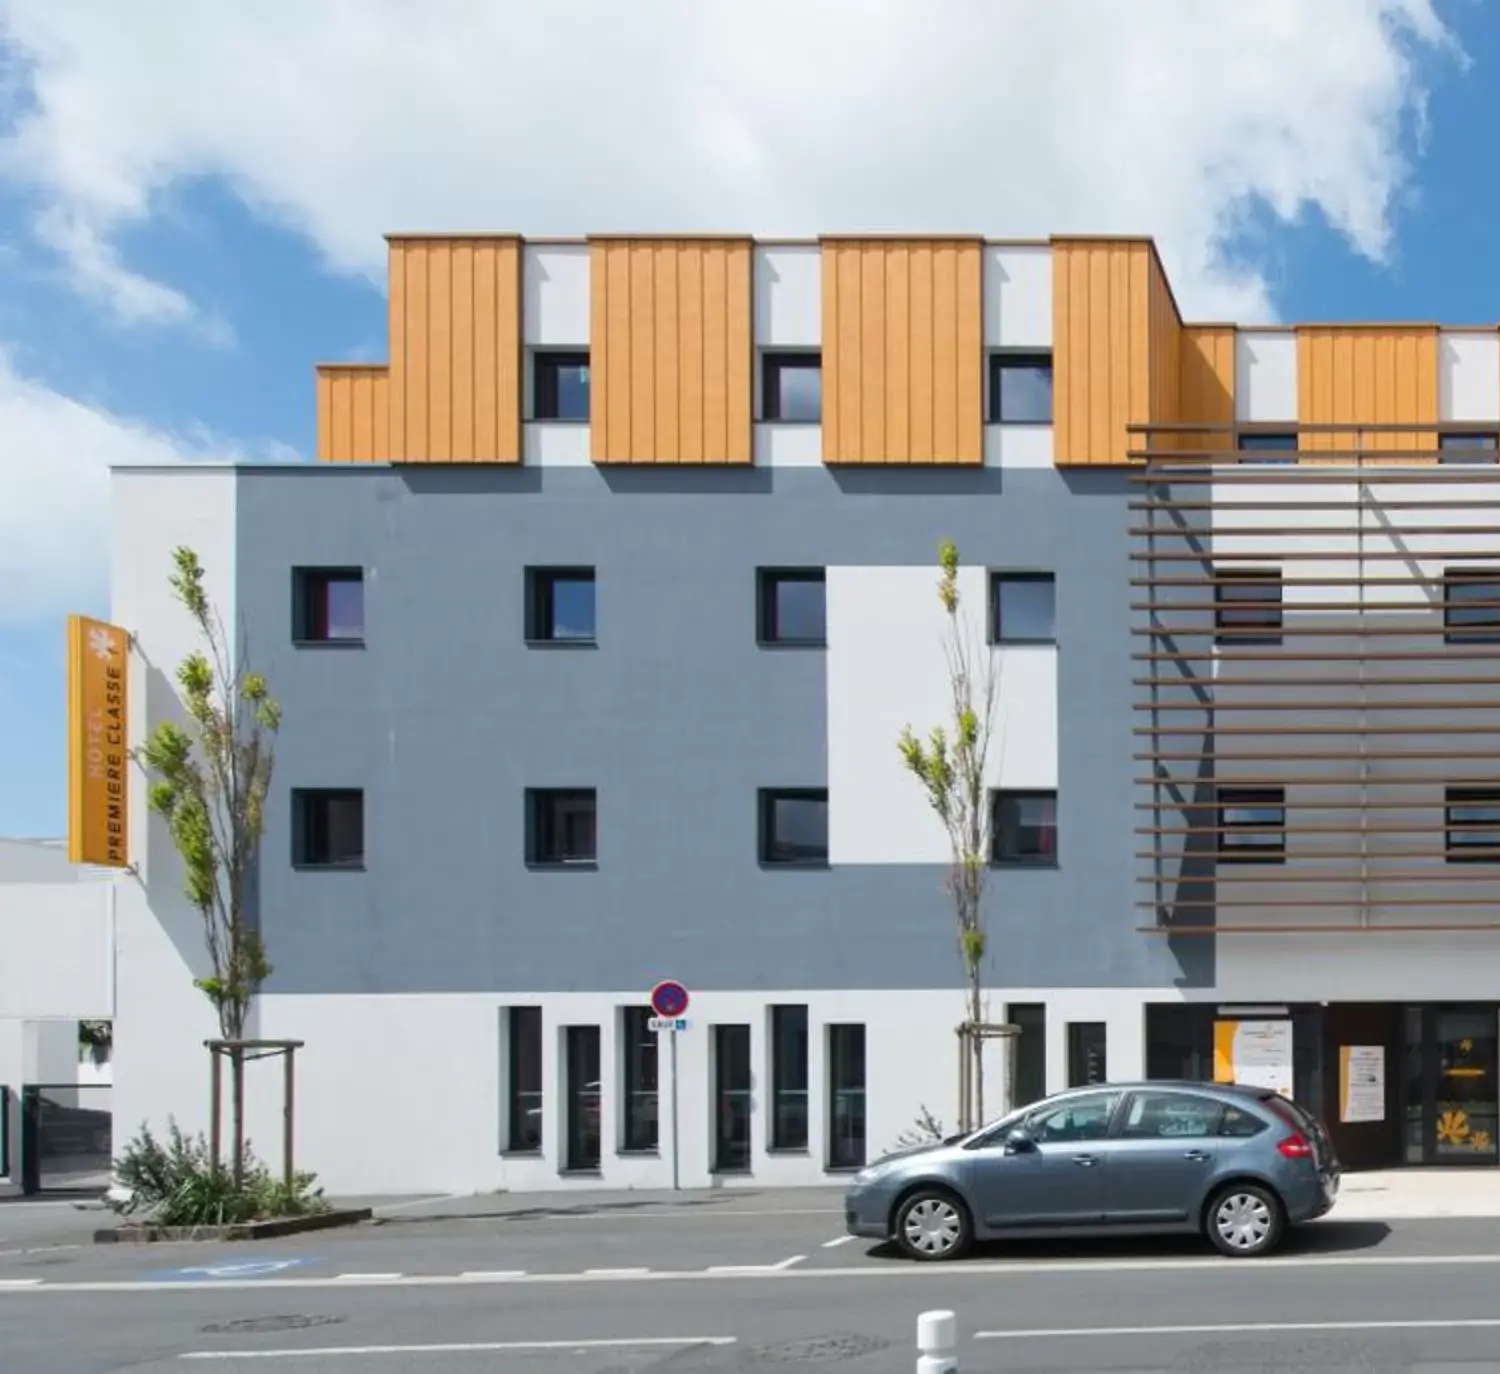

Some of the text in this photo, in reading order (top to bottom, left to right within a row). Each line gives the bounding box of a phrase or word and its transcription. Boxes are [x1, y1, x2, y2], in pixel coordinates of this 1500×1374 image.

[87, 709, 103, 778] HOTEL
[106, 665, 122, 863] PREMIERE CLASSE
